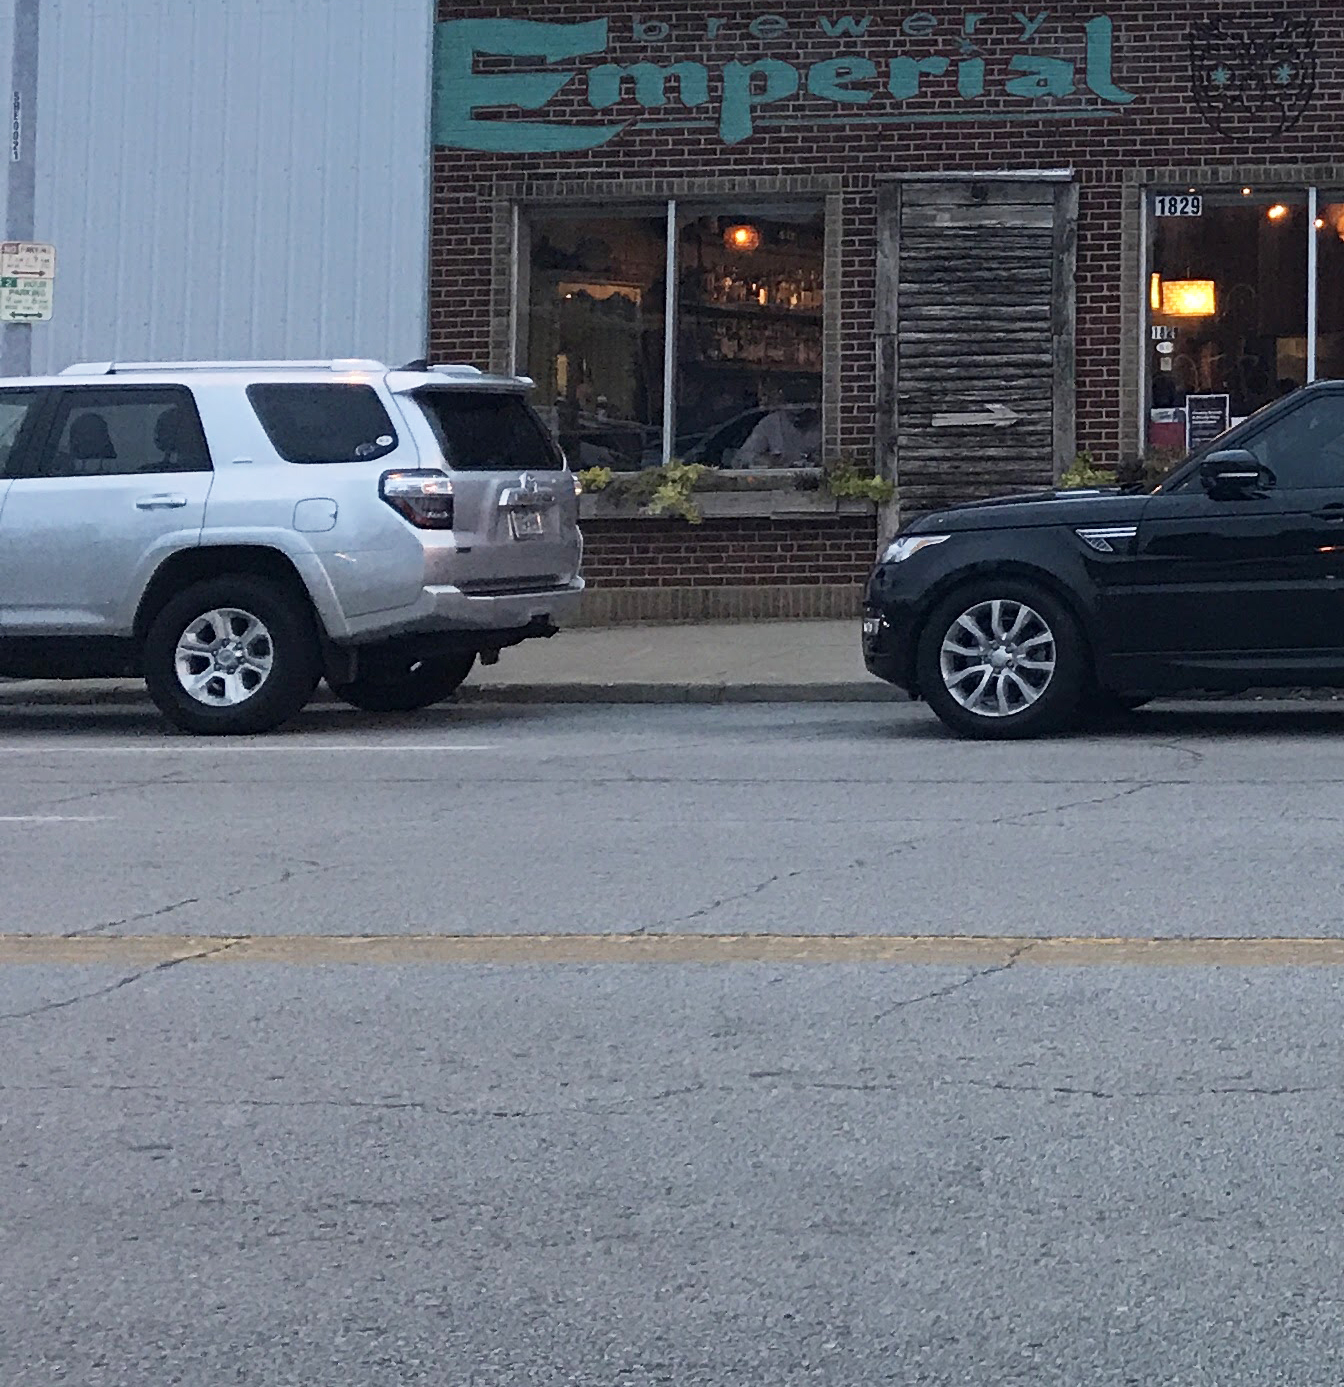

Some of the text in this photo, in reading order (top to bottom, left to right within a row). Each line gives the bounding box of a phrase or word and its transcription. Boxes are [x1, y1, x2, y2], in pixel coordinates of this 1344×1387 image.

[632, 11, 1050, 42] brewery
[434, 14, 1140, 153] Emperial
[1158, 196, 1200, 215] 1829
